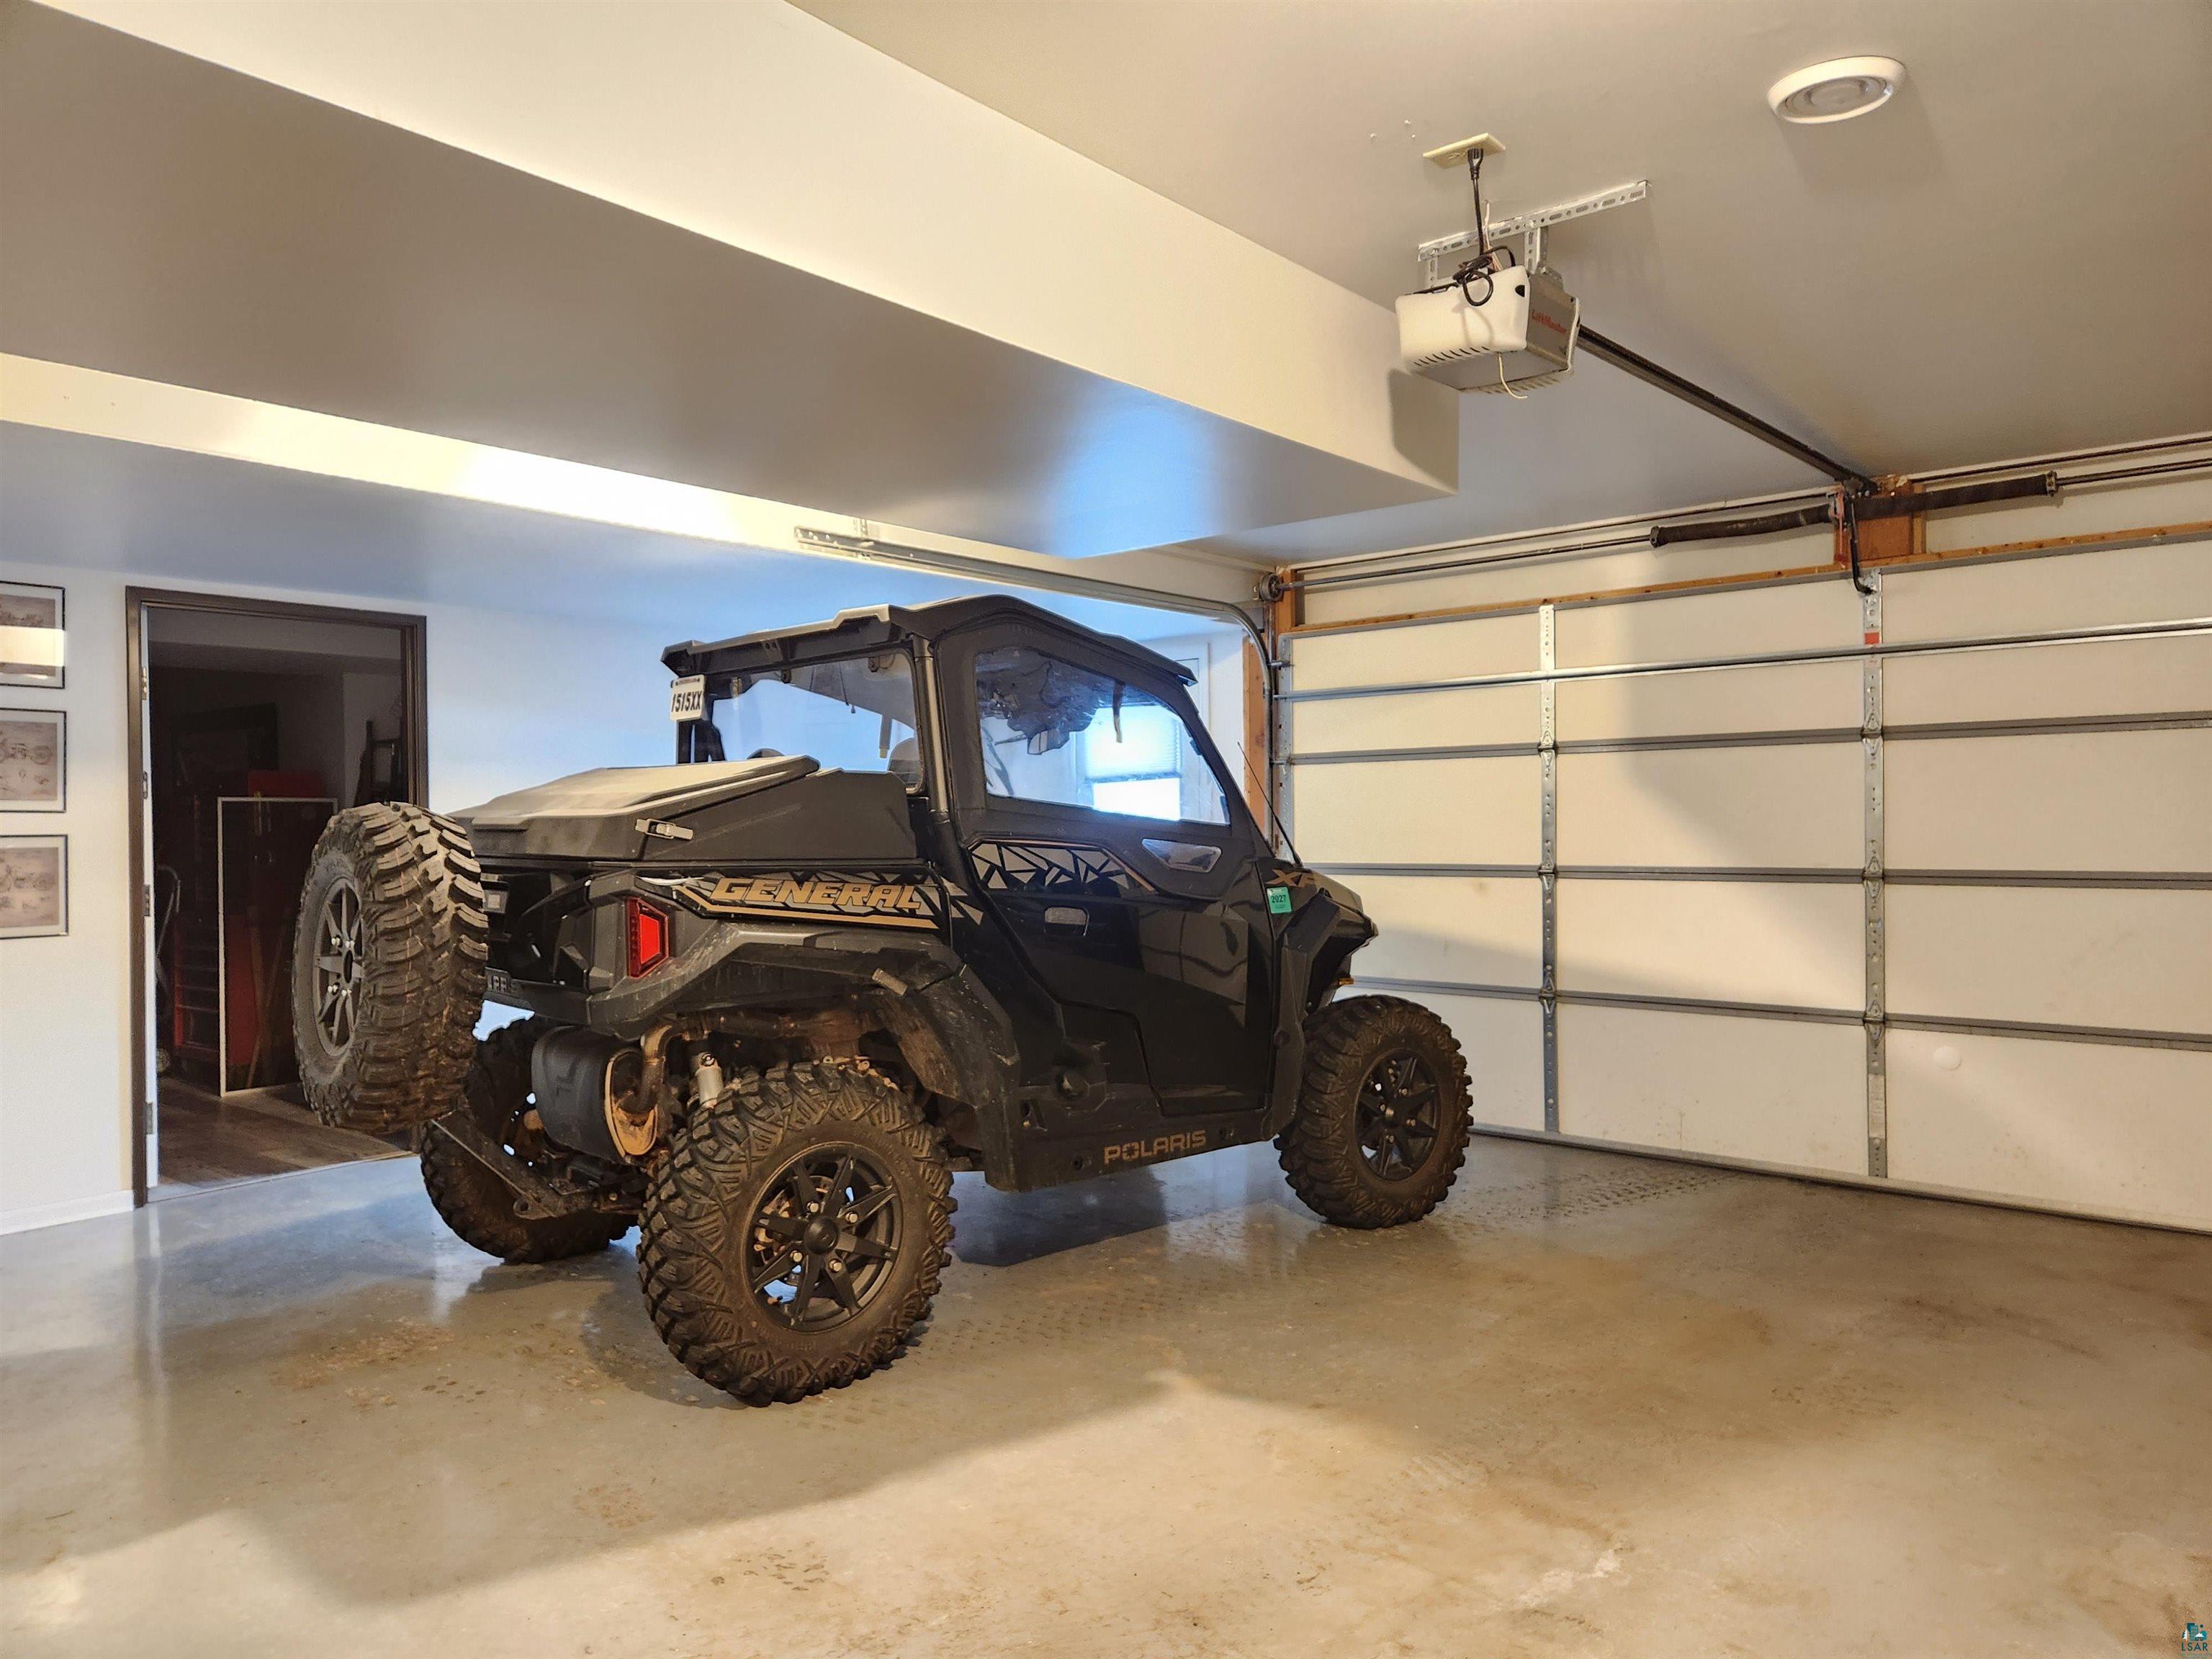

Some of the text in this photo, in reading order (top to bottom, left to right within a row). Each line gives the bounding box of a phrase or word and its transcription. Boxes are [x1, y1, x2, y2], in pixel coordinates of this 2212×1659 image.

[671, 691, 703, 712] 1515XX
[710, 878, 922, 909] GENERAL
[1103, 1130, 1207, 1164] POLARIS
